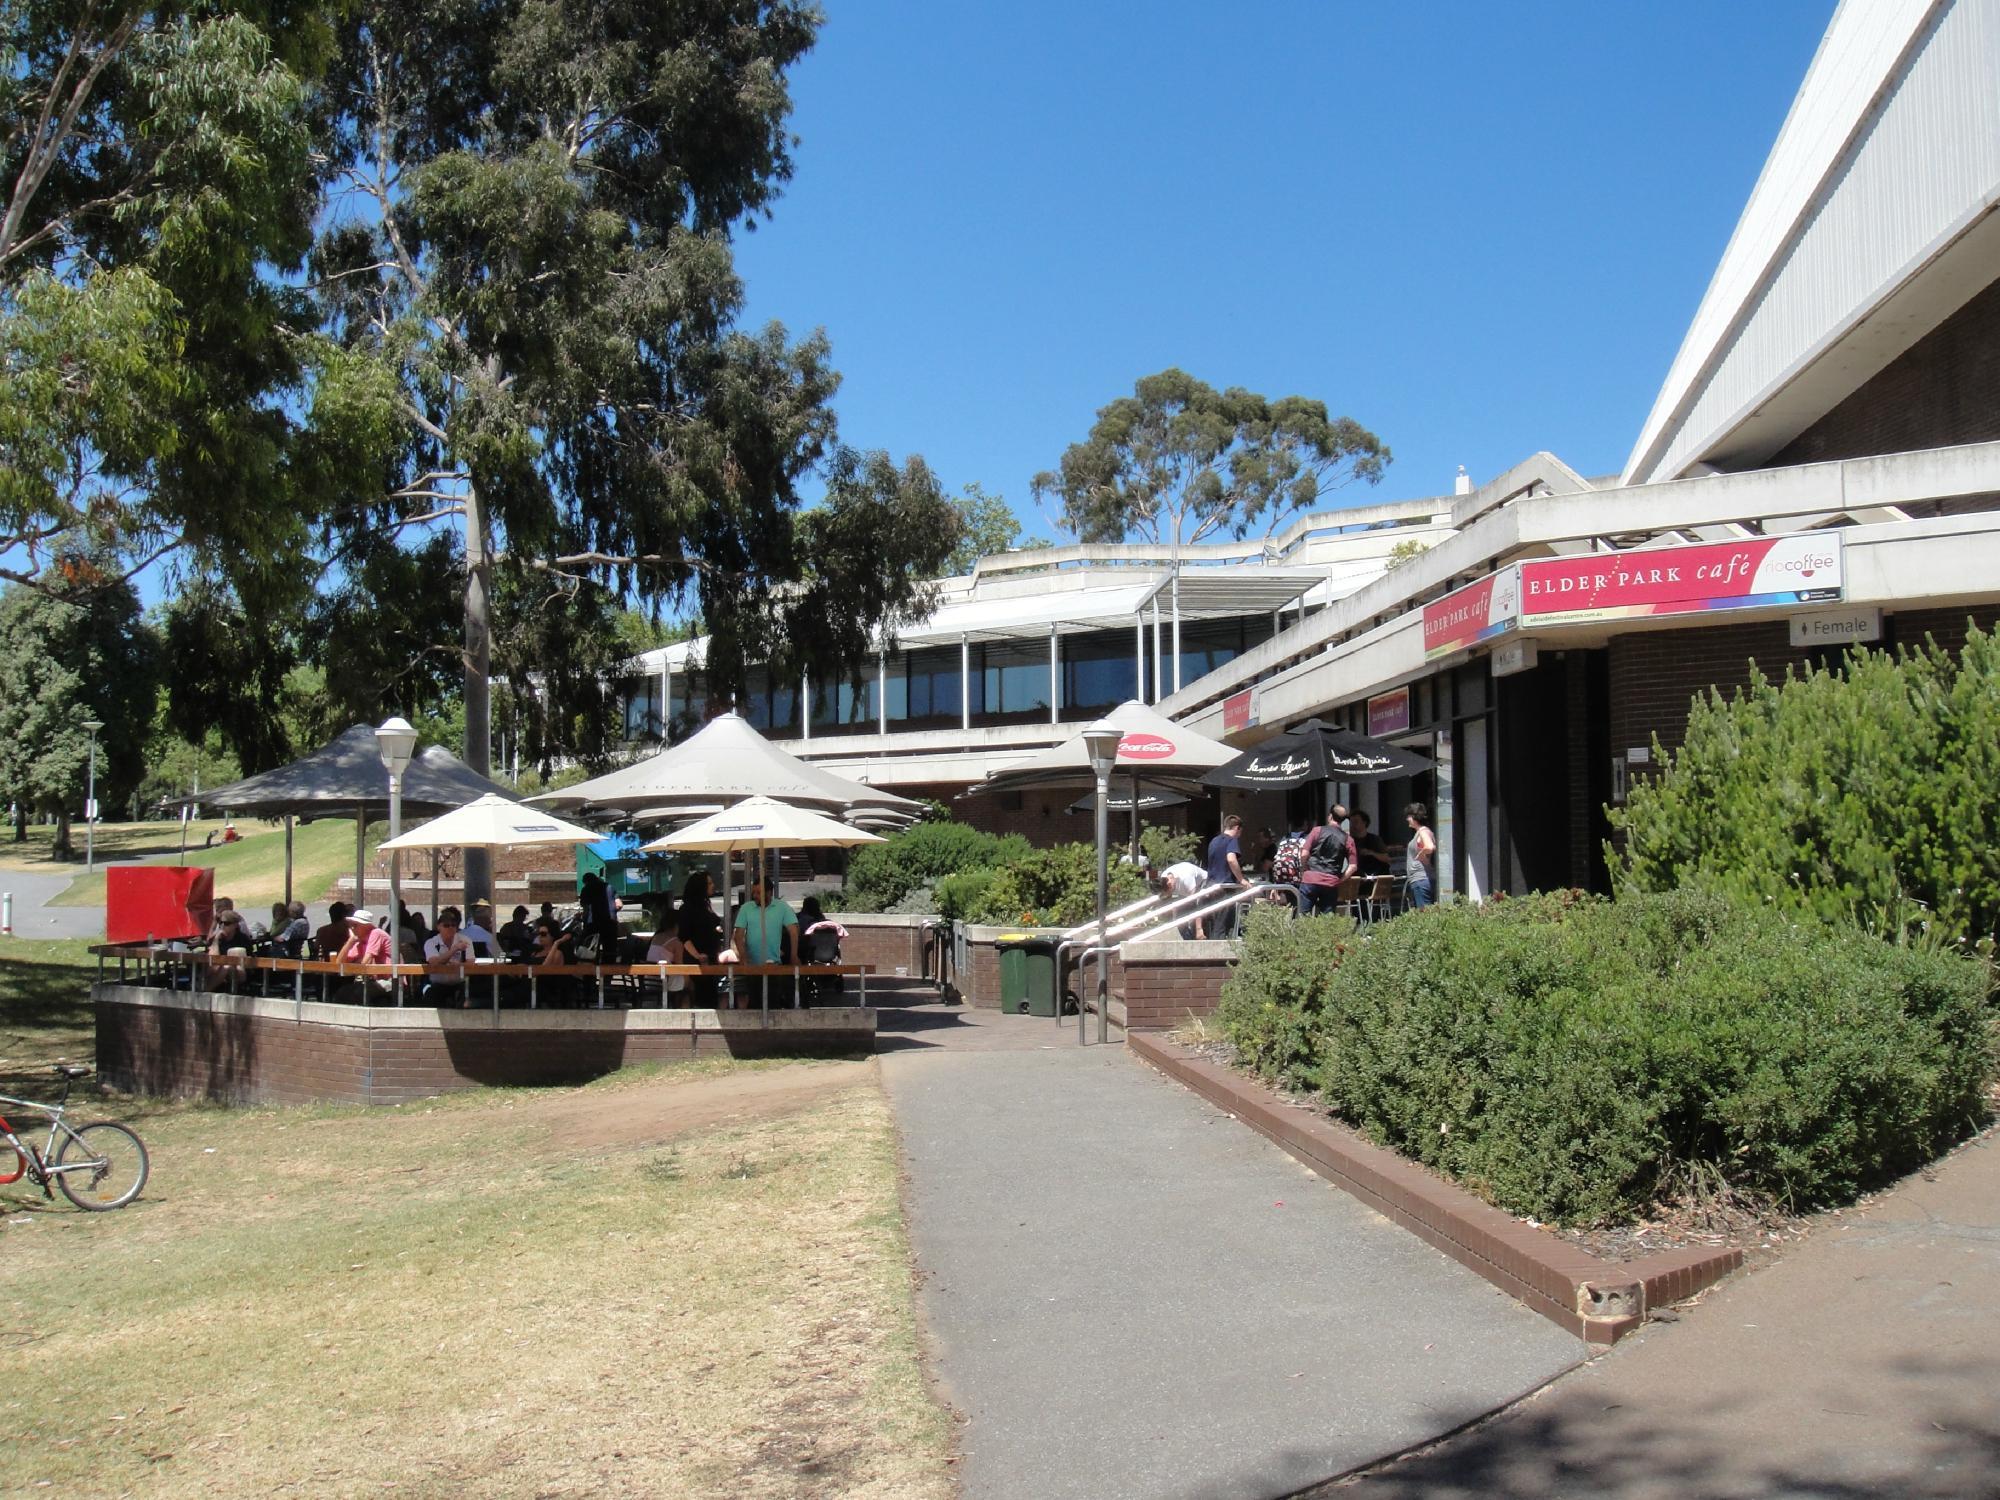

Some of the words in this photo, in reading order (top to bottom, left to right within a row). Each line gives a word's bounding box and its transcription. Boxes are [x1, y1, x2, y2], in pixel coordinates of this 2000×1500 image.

[1529, 574, 1607, 595] ELDER
[1618, 567, 1681, 586] PARK
[1696, 554, 1750, 583] café
[1425, 615, 1449, 636] ELDER
[1450, 606, 1469, 626] PARK
[1814, 617, 1867, 635] Female
